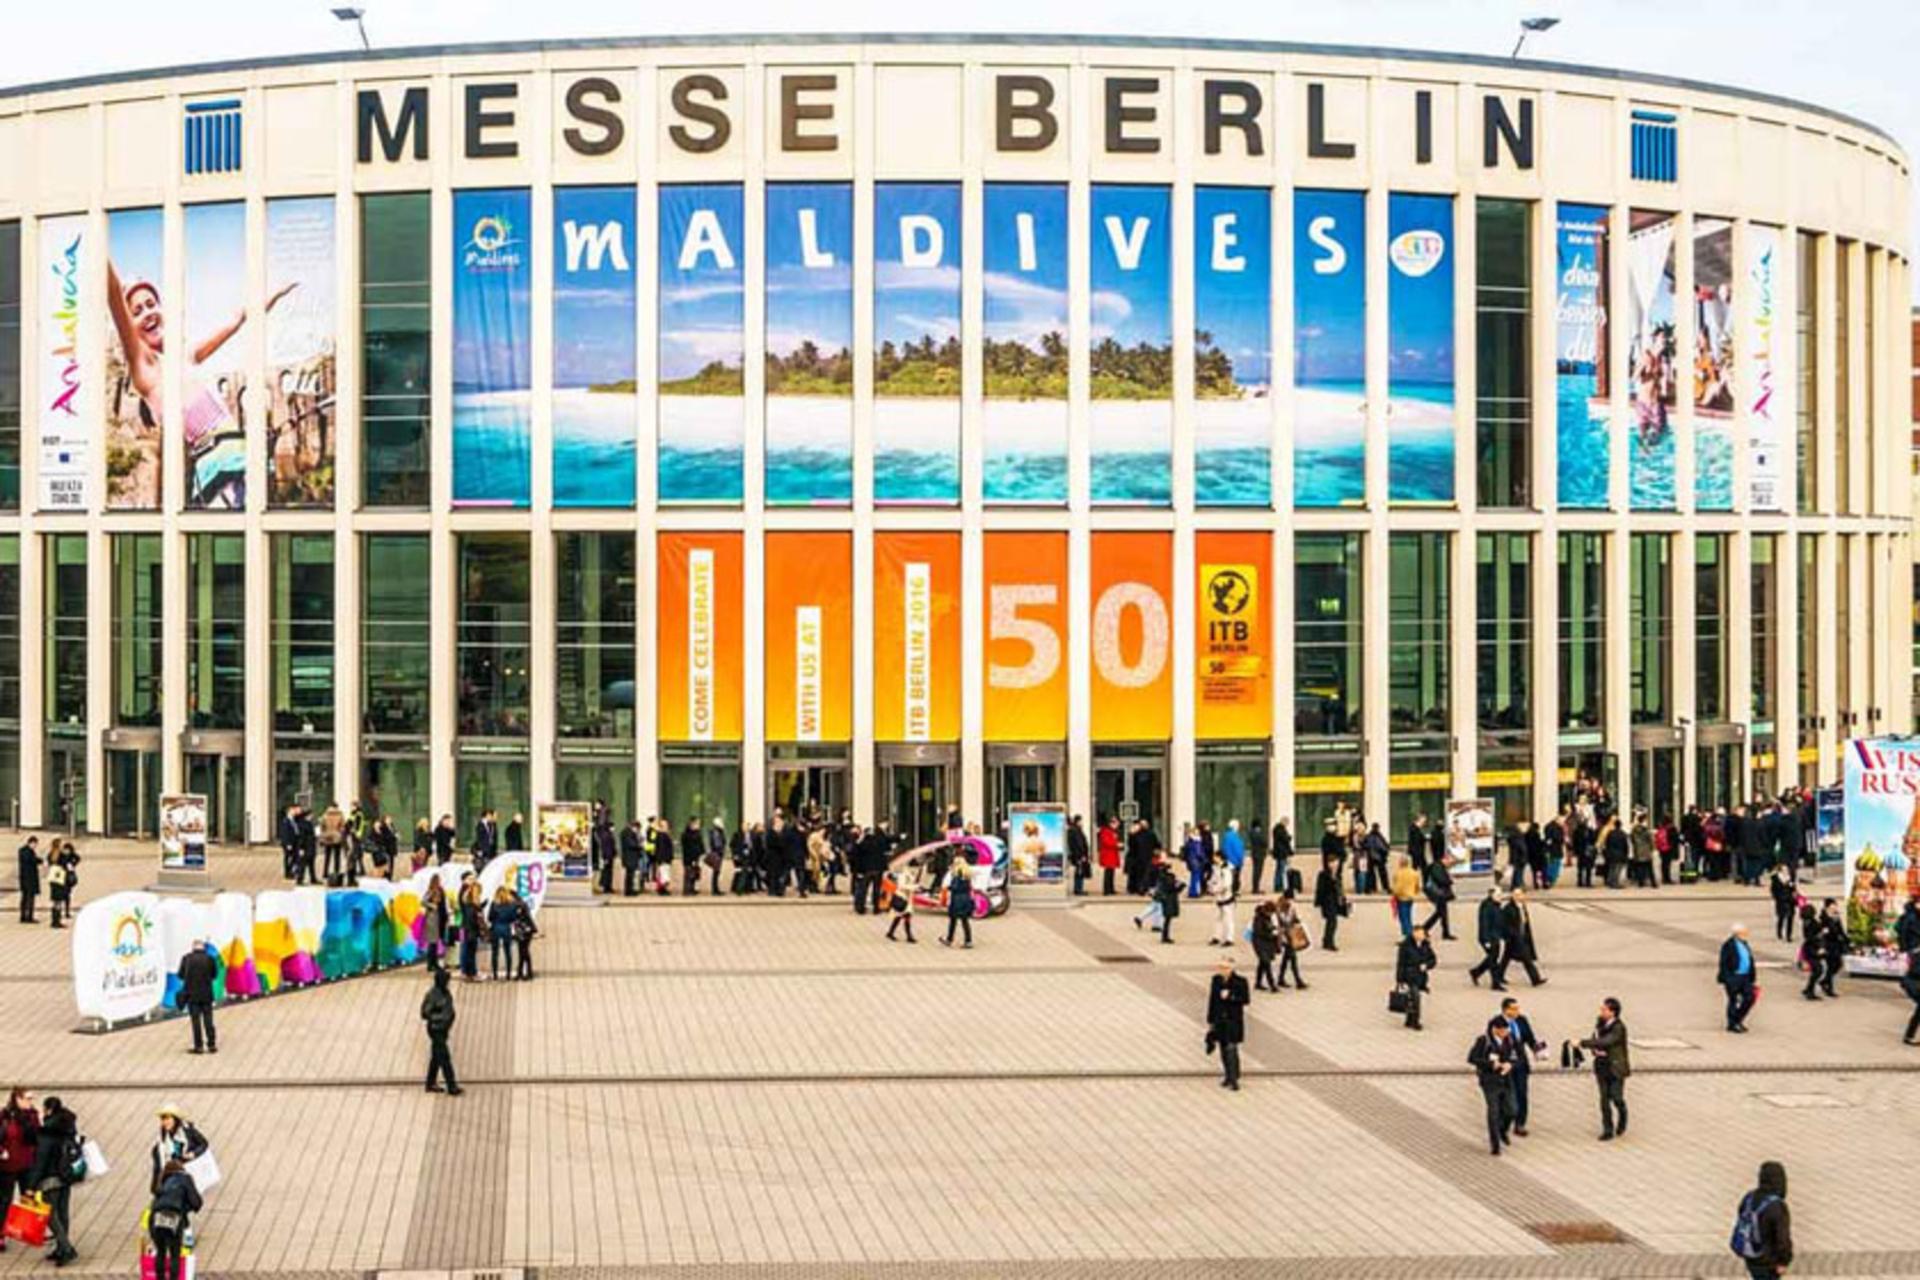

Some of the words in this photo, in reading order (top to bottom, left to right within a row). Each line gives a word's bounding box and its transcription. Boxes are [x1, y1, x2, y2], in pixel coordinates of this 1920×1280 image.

[357, 76, 837, 163] MESSE
[997, 76, 1533, 169] BERLIN
[694, 562, 709, 669] CELEBRATE
[910, 575, 925, 624] 2016
[802, 622, 817, 646] AT
[1209, 621, 1249, 641] ITB
[802, 653, 817, 678] US
[910, 631, 925, 700] BERLIN
[694, 675, 709, 733] COME
[802, 684, 817, 734] WITH
[910, 705, 925, 736] ITB
